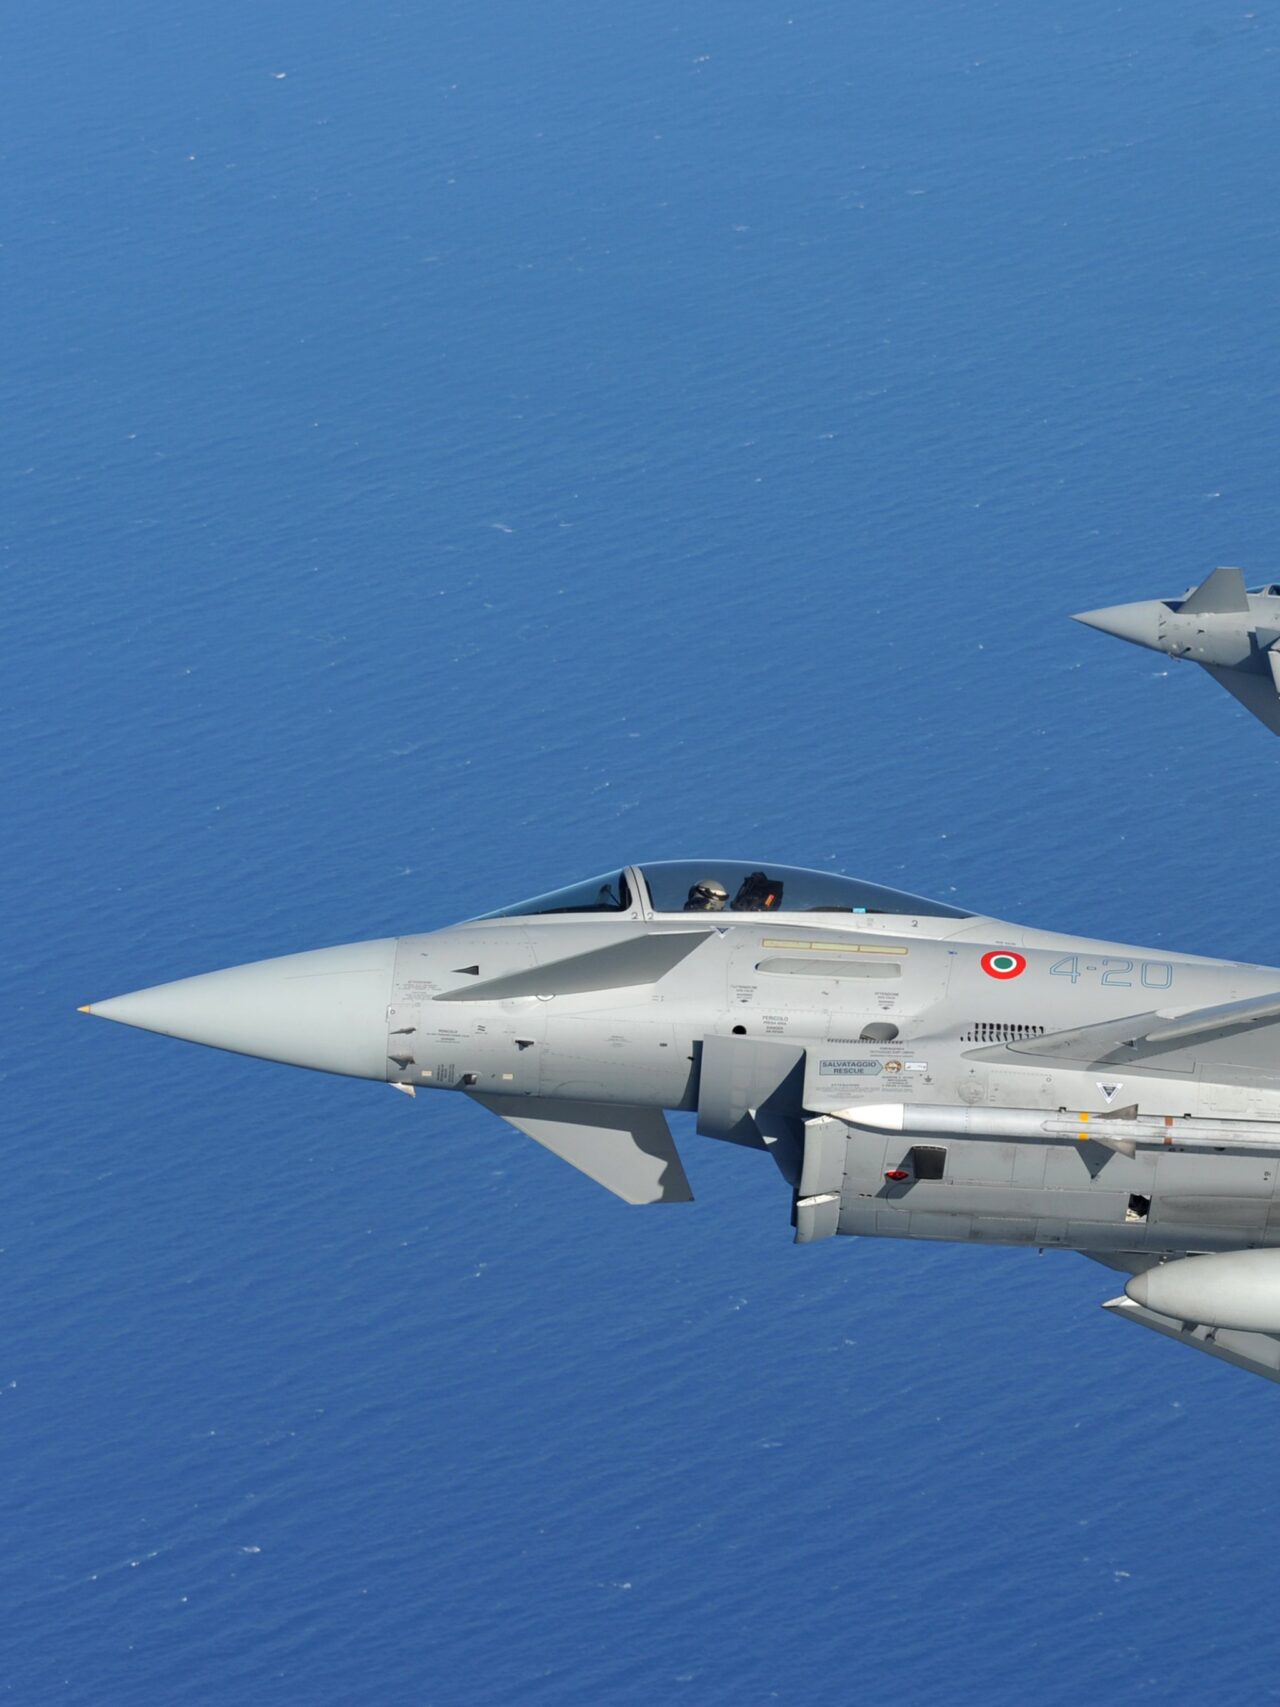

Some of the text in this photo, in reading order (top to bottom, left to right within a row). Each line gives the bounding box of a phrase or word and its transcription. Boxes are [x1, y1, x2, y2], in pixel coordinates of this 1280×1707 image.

[631, 911, 639, 920] 2
[647, 911, 655, 920] 2
[911, 919, 919, 928] 2
[1049, 954, 1173, 989] 4-20
[822, 1060, 877, 1068] SALVATAGGIO
